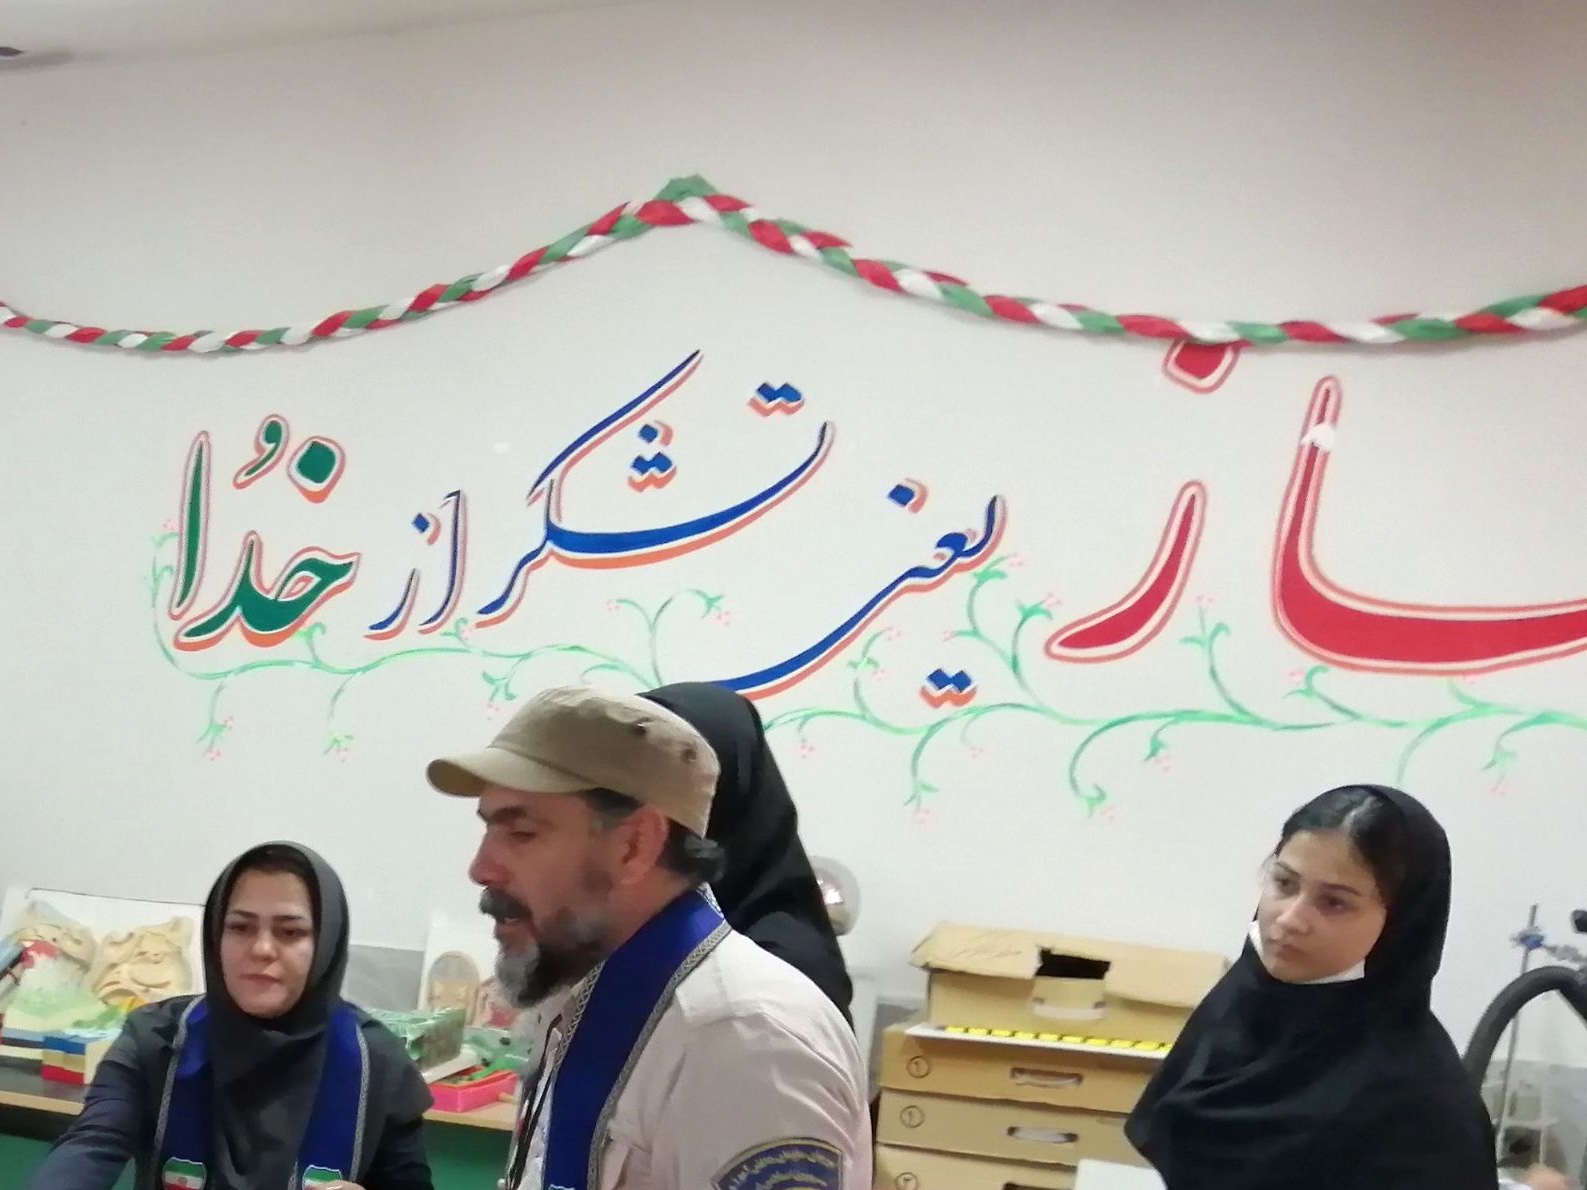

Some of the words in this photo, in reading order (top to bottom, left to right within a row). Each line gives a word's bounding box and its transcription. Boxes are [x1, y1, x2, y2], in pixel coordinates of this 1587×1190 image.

[364, 489, 467, 641] از
[475, 349, 836, 629] تشکر
[715, 477, 1007, 707] یعنی
